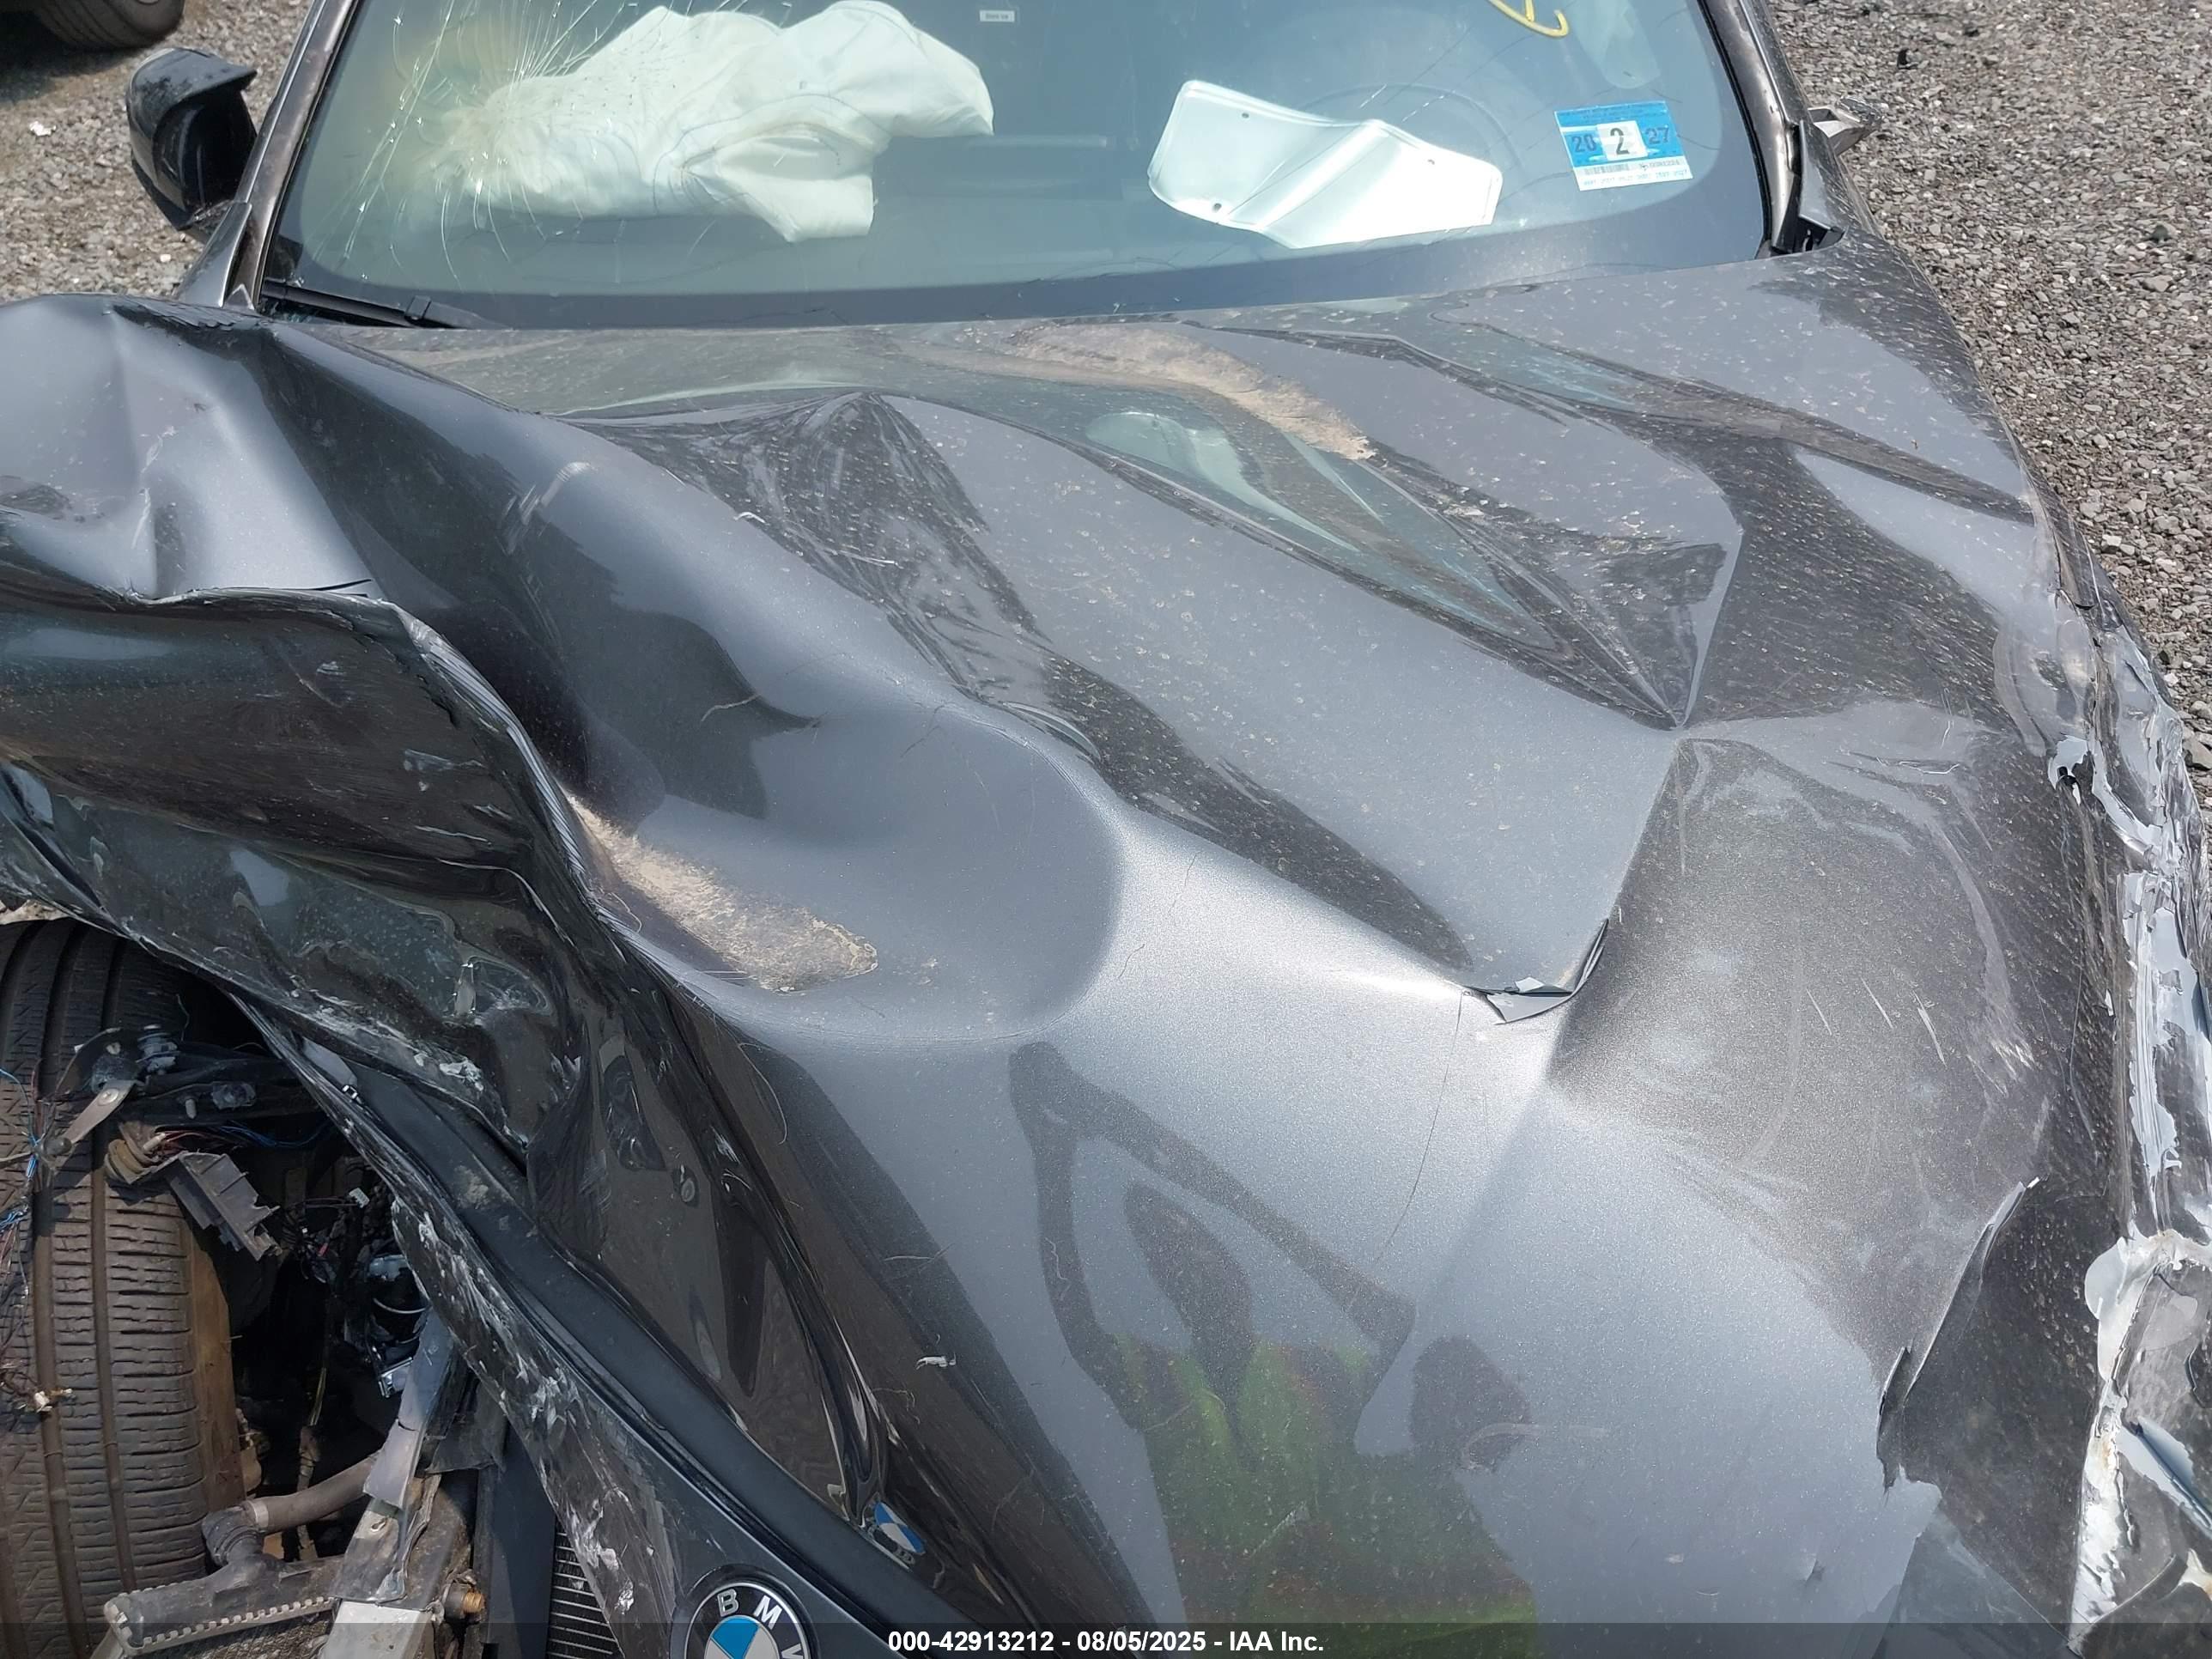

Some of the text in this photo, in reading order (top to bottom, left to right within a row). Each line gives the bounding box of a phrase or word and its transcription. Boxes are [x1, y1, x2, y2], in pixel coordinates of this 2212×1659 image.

[1571, 126, 1670, 155] 20 2 27
